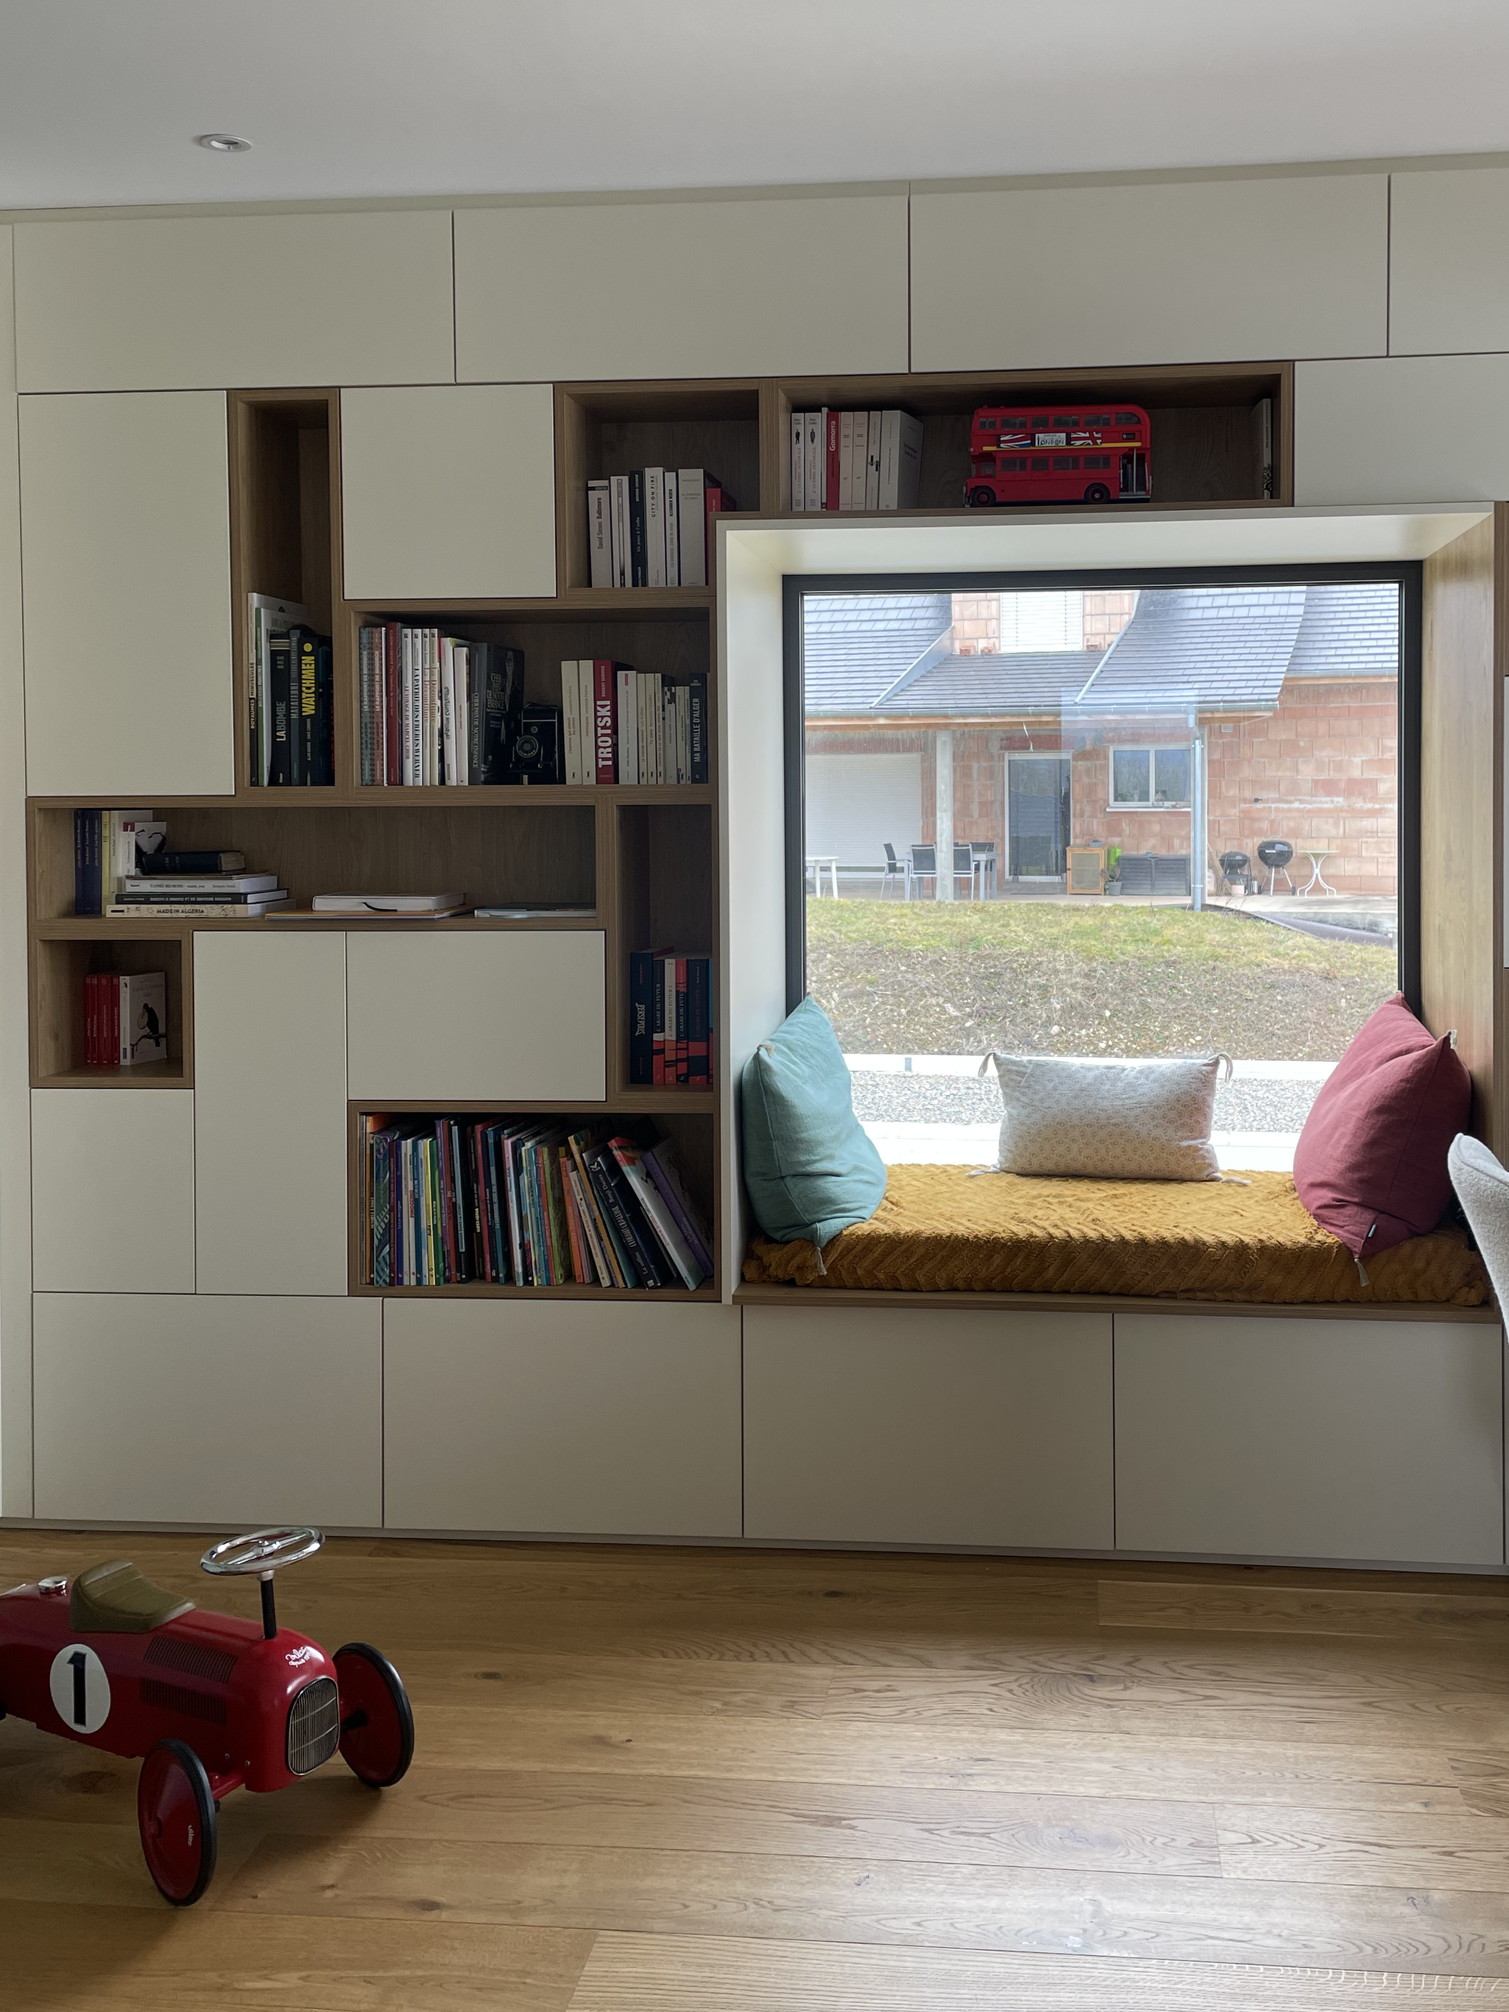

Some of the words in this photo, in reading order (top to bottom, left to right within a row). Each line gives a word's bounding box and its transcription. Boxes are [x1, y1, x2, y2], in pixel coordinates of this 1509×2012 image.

[650, 491, 655, 500] ON
[301, 656, 315, 716] WATCHMEN
[276, 701, 287, 731] BOMBE
[693, 698, 701, 722] D'ALGER
[596, 700, 612, 768] TROTSKI
[693, 724, 701, 751] BATAILLE
[693, 752, 701, 763] MA
[634, 1002, 646, 1036] PERSEPOLIS
[66, 1650, 87, 1727] 1
